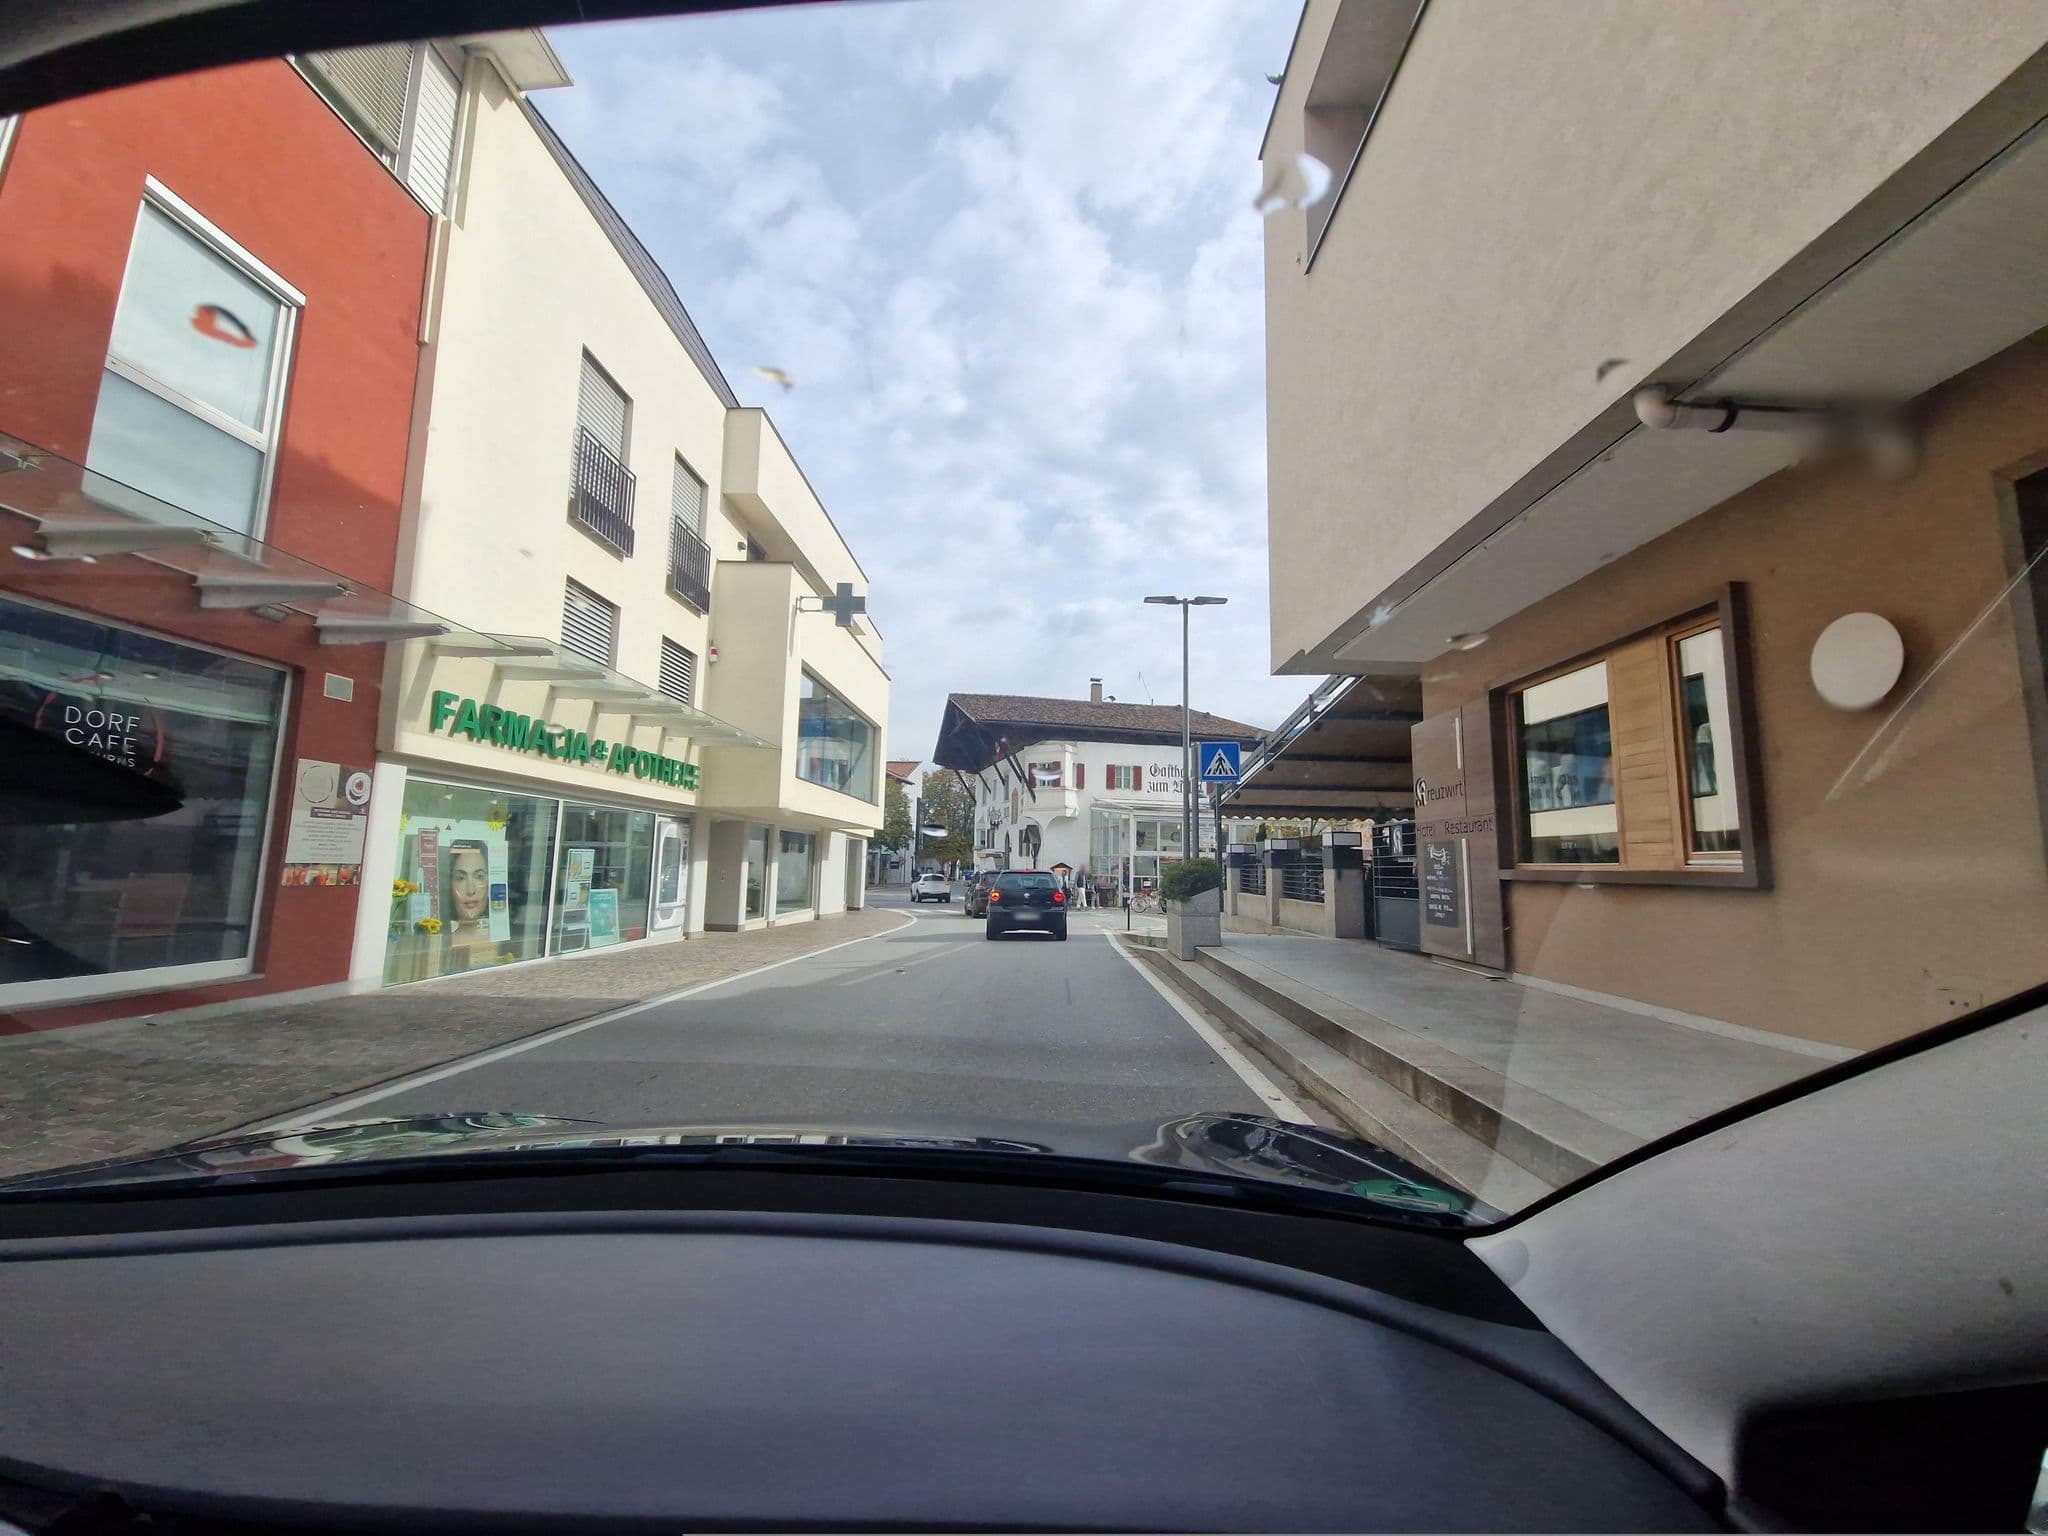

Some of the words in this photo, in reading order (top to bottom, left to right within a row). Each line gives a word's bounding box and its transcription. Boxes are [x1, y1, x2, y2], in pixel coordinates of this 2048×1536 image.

[65, 705, 141, 733] DORF
[65, 727, 137, 755] CAFE
[429, 689, 592, 767] FARMACIA
[606, 742, 701, 792] APOTHEKE
[1444, 818, 1494, 835] Restaurant
